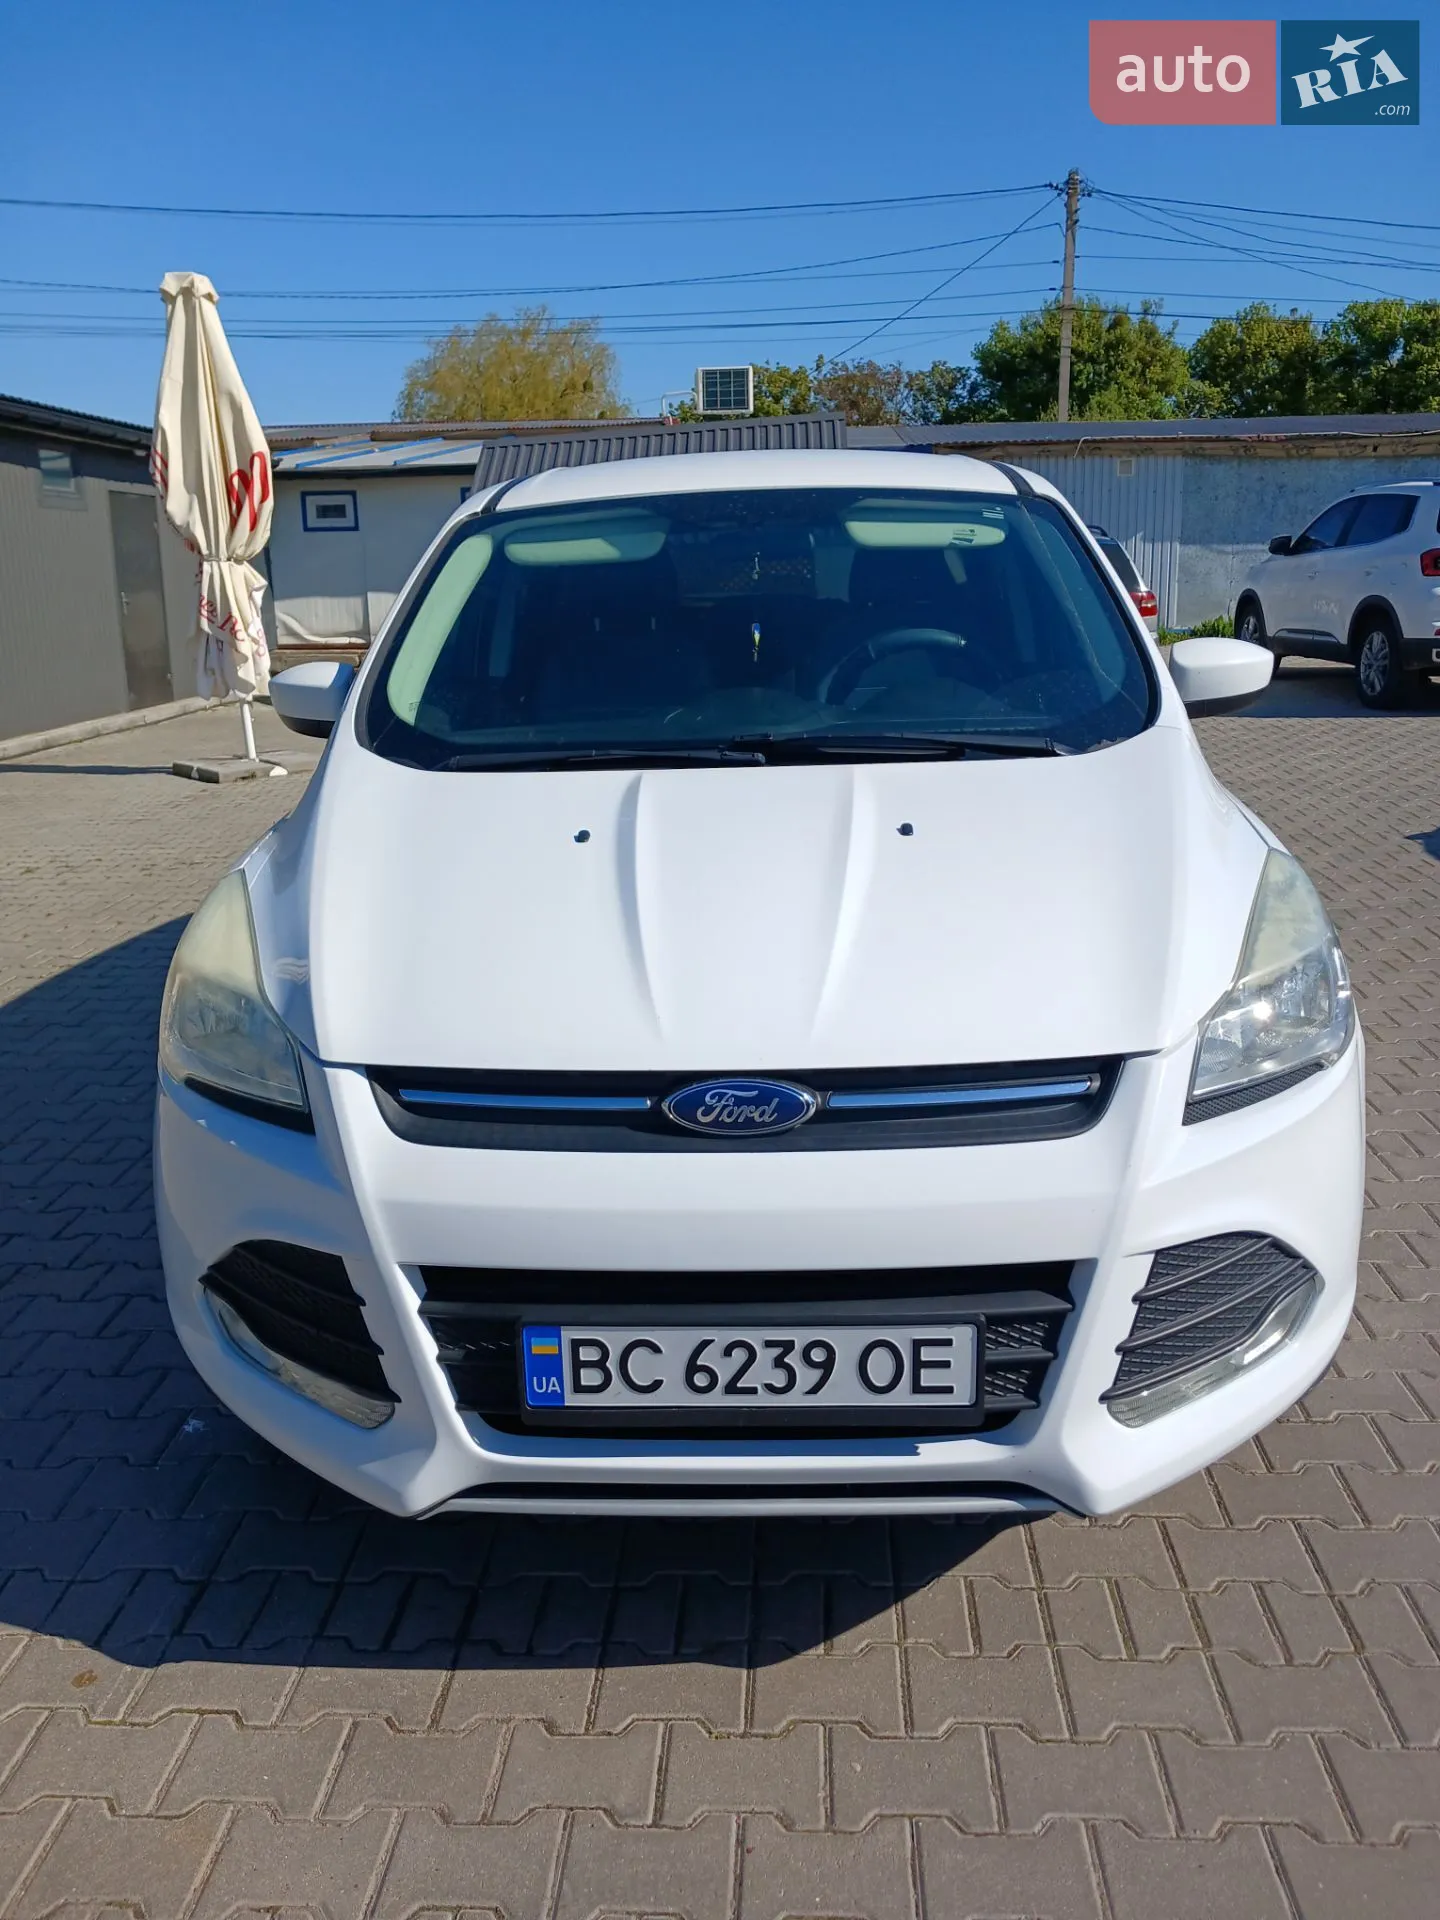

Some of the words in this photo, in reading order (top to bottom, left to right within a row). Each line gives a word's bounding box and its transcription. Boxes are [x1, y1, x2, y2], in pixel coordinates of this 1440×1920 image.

[696, 1089, 780, 1123] Ford
[569, 1338, 664, 1395] BC
[684, 1338, 837, 1396] 6239
[857, 1338, 956, 1395] OE
[532, 1376, 562, 1394] UA
